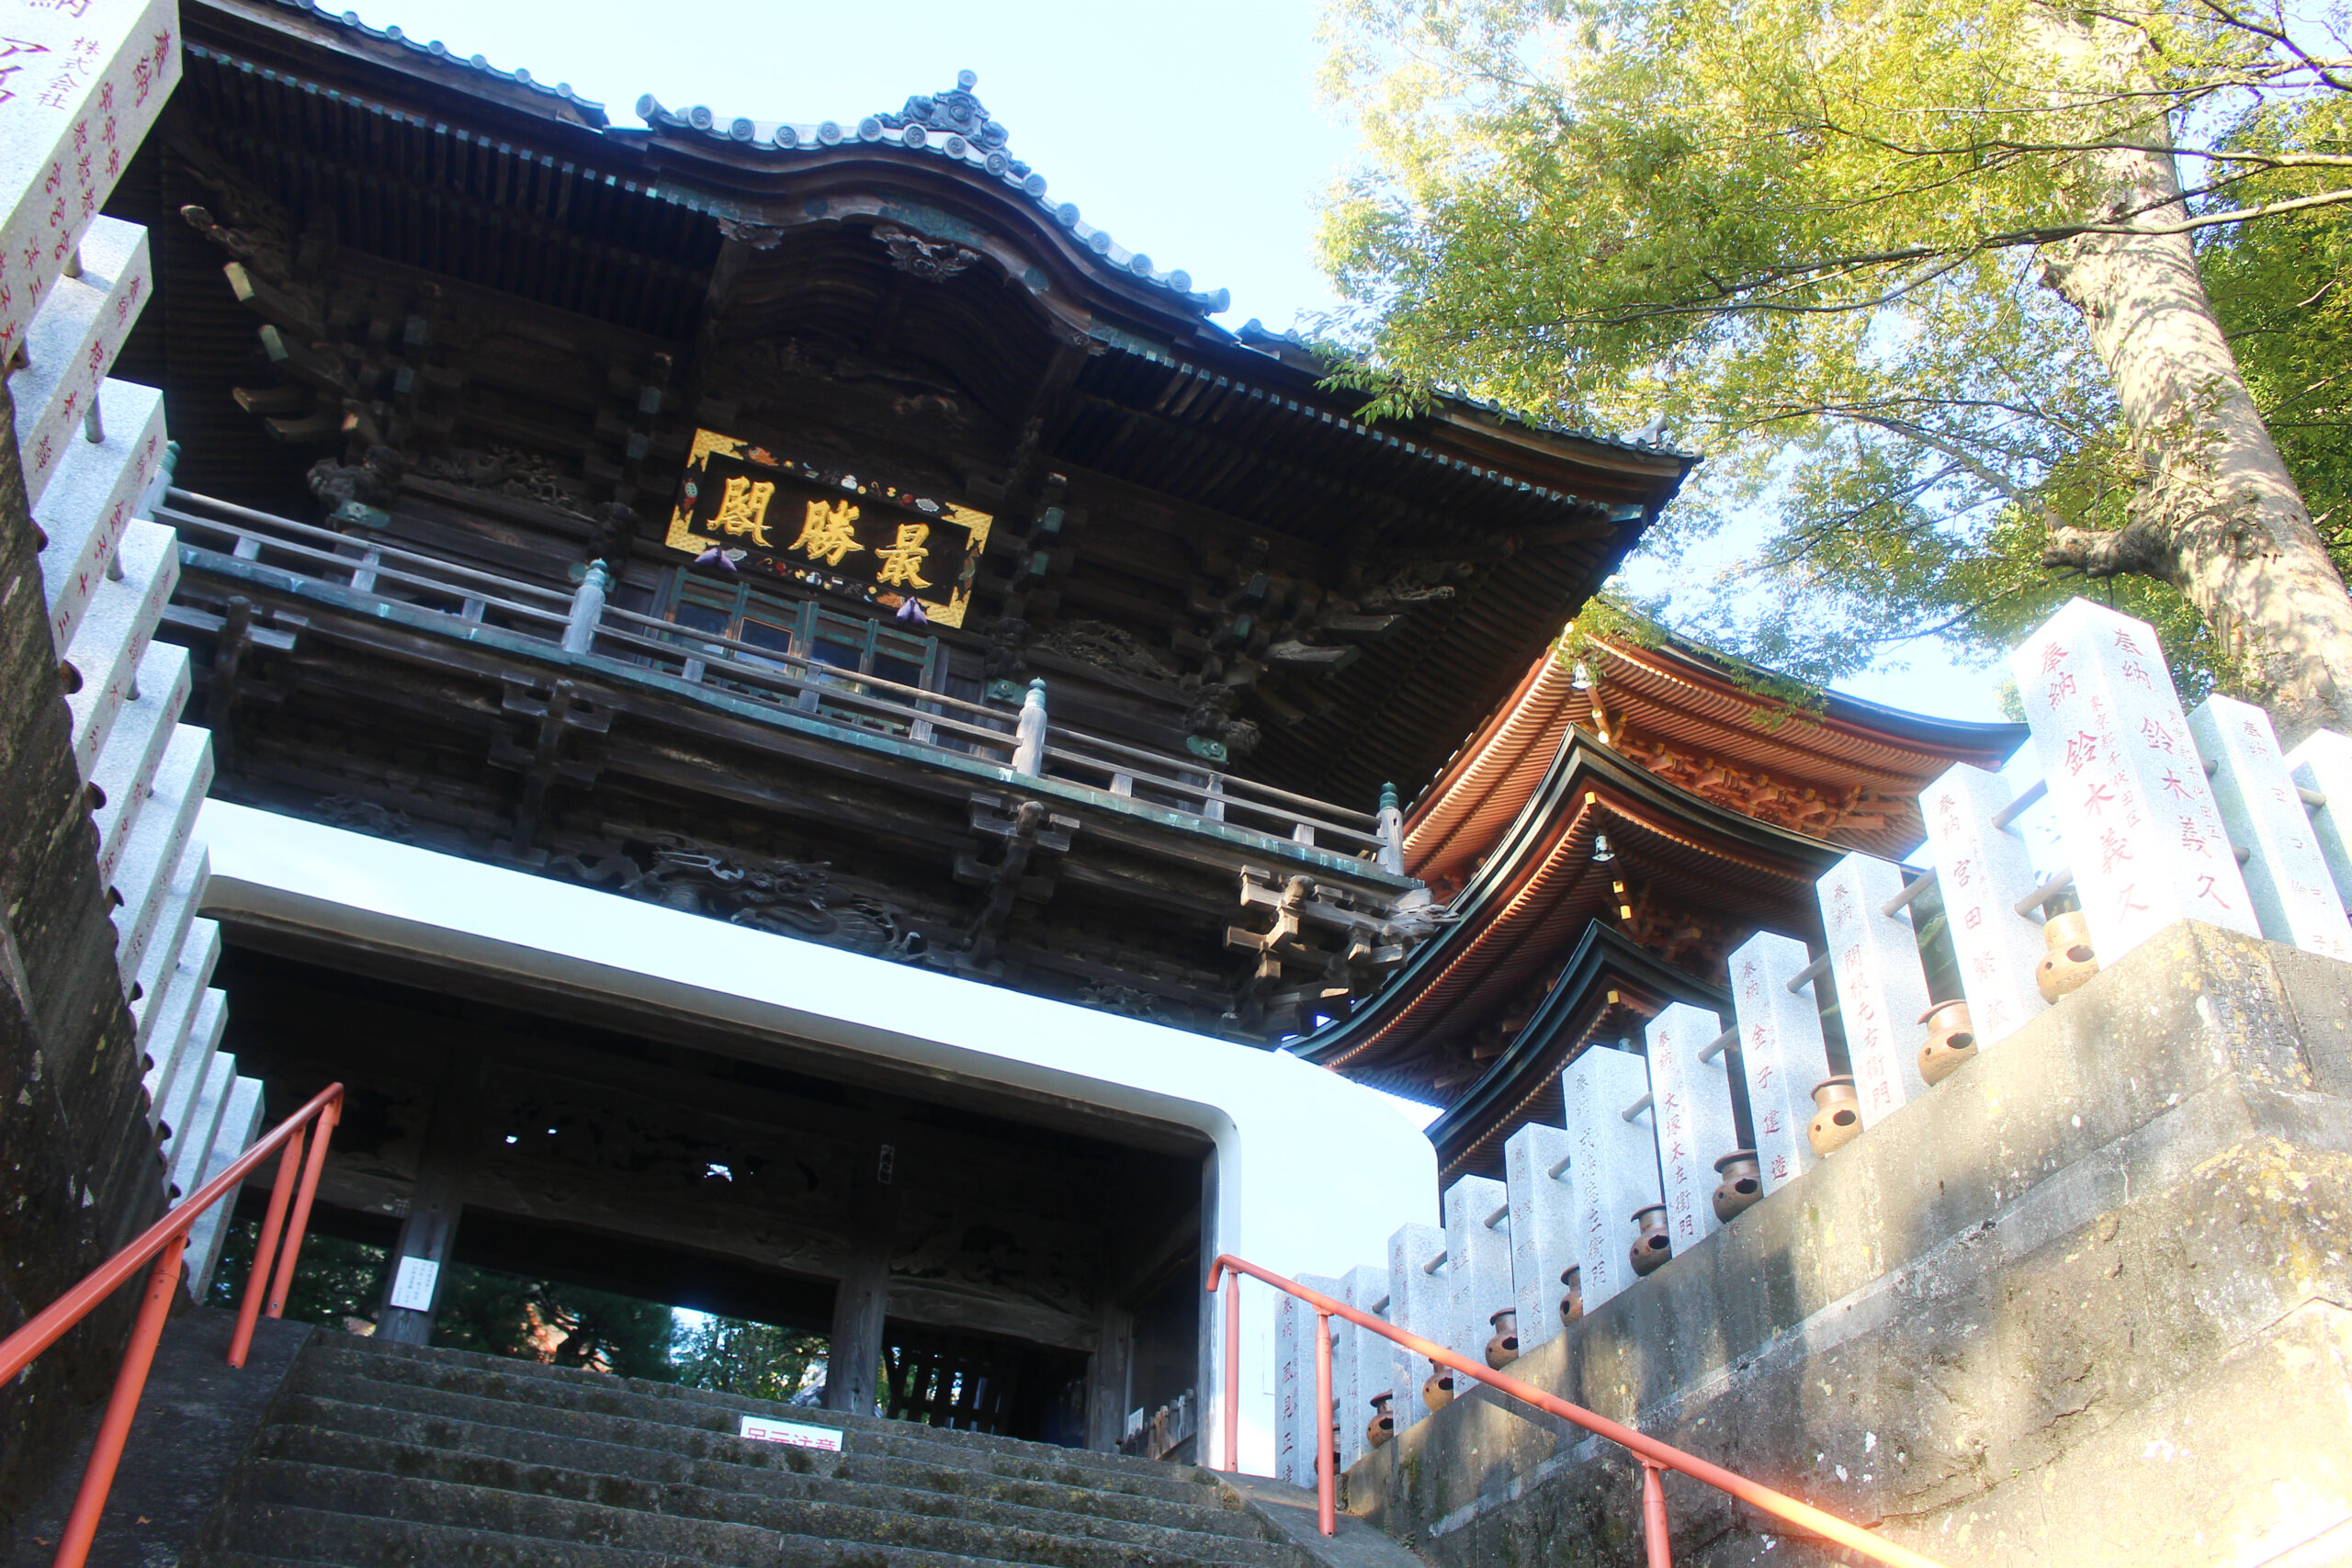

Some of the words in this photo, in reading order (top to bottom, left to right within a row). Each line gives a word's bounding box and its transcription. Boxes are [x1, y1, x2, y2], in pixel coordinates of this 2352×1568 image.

[34, 36, 101, 110] 株式会社
[707, 476, 933, 589] 最勝閣
[2041, 641, 2077, 712] 奉納
[2064, 730, 2149, 924] 鈴木義久
[2090, 694, 2141, 828] 東京都千代田区
[2114, 628, 2152, 691] 奉納
[2141, 716, 2232, 909] 鈴木義久
